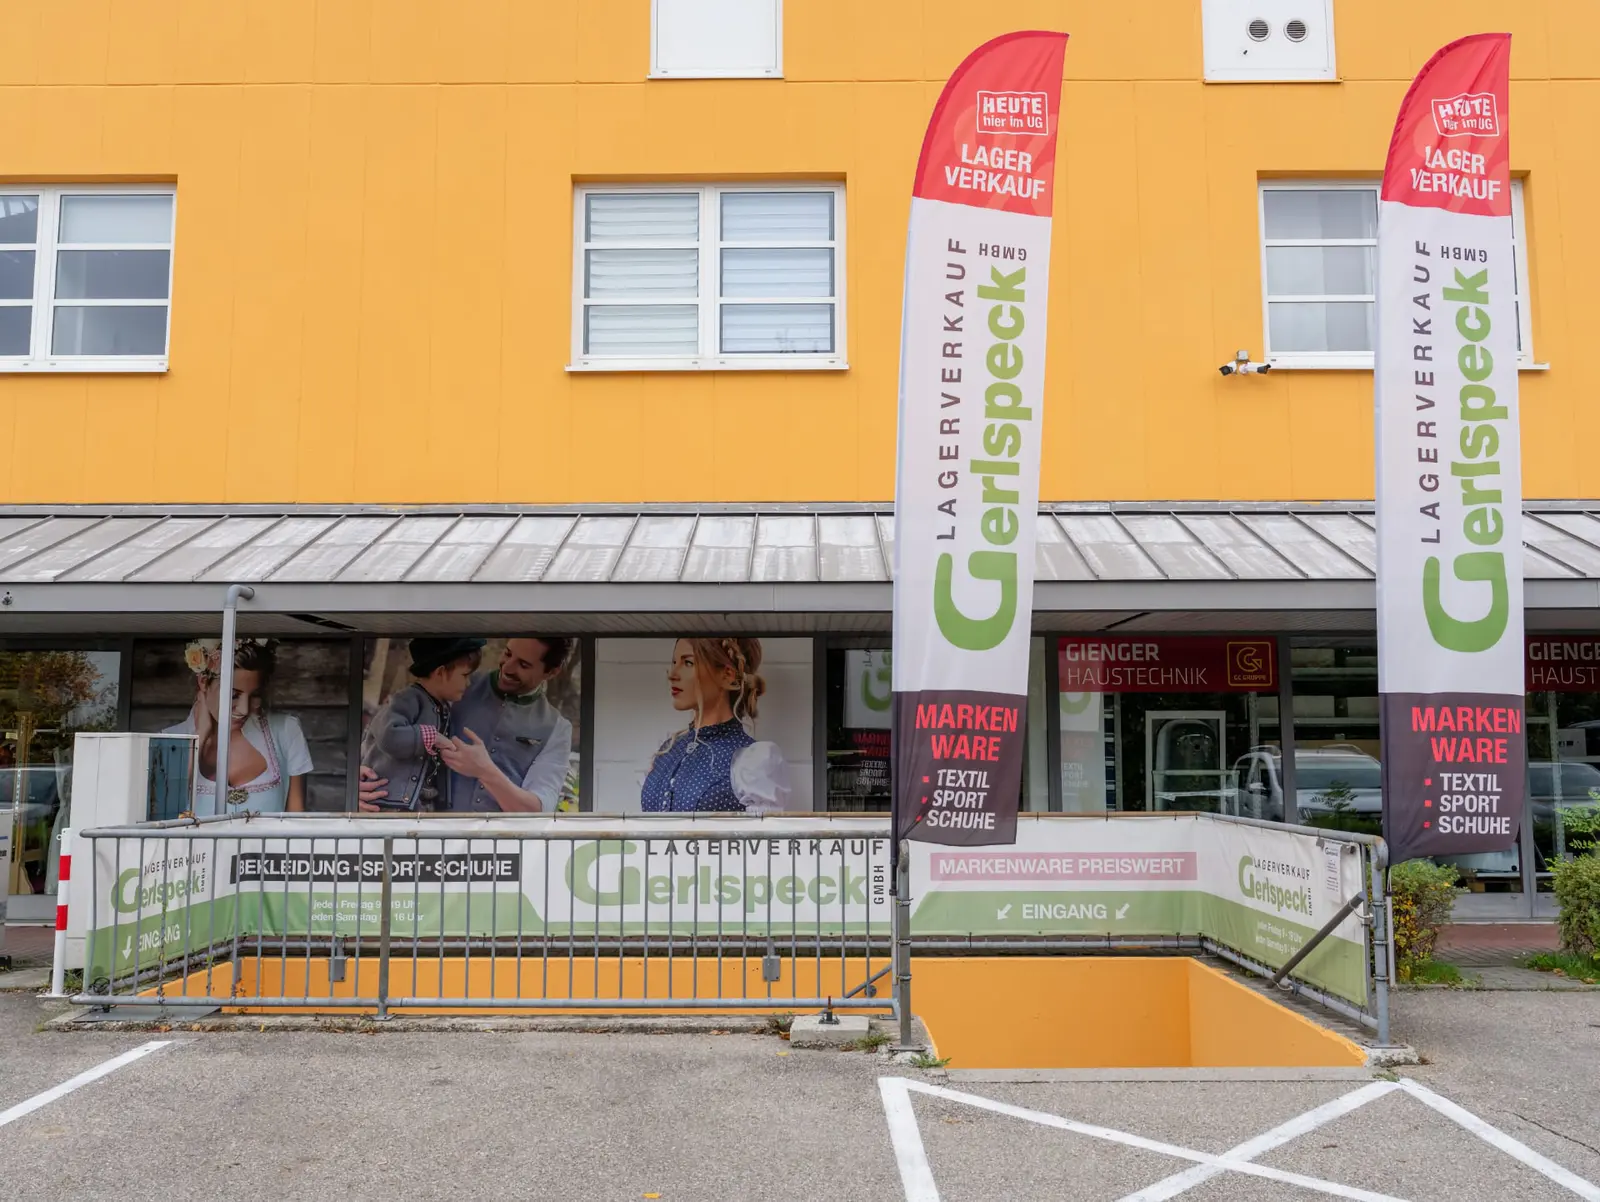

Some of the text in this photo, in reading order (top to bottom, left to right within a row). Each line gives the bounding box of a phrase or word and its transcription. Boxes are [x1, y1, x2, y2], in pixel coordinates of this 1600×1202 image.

[983, 96, 1042, 115] HEUTE
[983, 115, 1043, 129] hier im UG
[1478, 118, 1493, 131] UG
[961, 143, 1032, 174] LAGER
[1425, 145, 1486, 176] LAGER
[944, 165, 1047, 200] VERKAUF
[1410, 167, 1502, 201] VERKAUF
[979, 242, 1027, 261] GMBH
[1440, 245, 1488, 262] GMBH
[937, 238, 967, 539] LAGERVERKAUF
[1412, 240, 1441, 544] LAGERVERKAUF
[934, 267, 1032, 651] Gerlspeck
[1423, 267, 1509, 653] Gerlspeck
[1065, 643, 1160, 662] GIENGER
[1067, 667, 1208, 686] HAUSTECHNIK
[915, 703, 1018, 733] MARKEN
[1411, 706, 1521, 734] MARKEN
[931, 735, 1001, 763] WARE
[1430, 736, 1508, 764] WARE
[937, 768, 990, 789] TEXTIL
[1439, 773, 1502, 792] TEXTIL
[932, 790, 987, 809] SPORT
[1438, 794, 1500, 814] SPORT
[926, 809, 996, 830] SCHUHE
[1437, 814, 1511, 835] SCHUHE
[648, 839, 885, 856] LAGERVERKAUF
[434, 860, 512, 877] SCHUHE
[564, 839, 868, 914] Gerlspeck
[938, 857, 1186, 875] MARKENWARE PREISWERT
[1253, 857, 1311, 881] LAGERVERKAUF
[873, 865, 885, 904] GMBH
[1238, 855, 1308, 916] Gerlspeck
[1021, 902, 1108, 920] EINGANG
